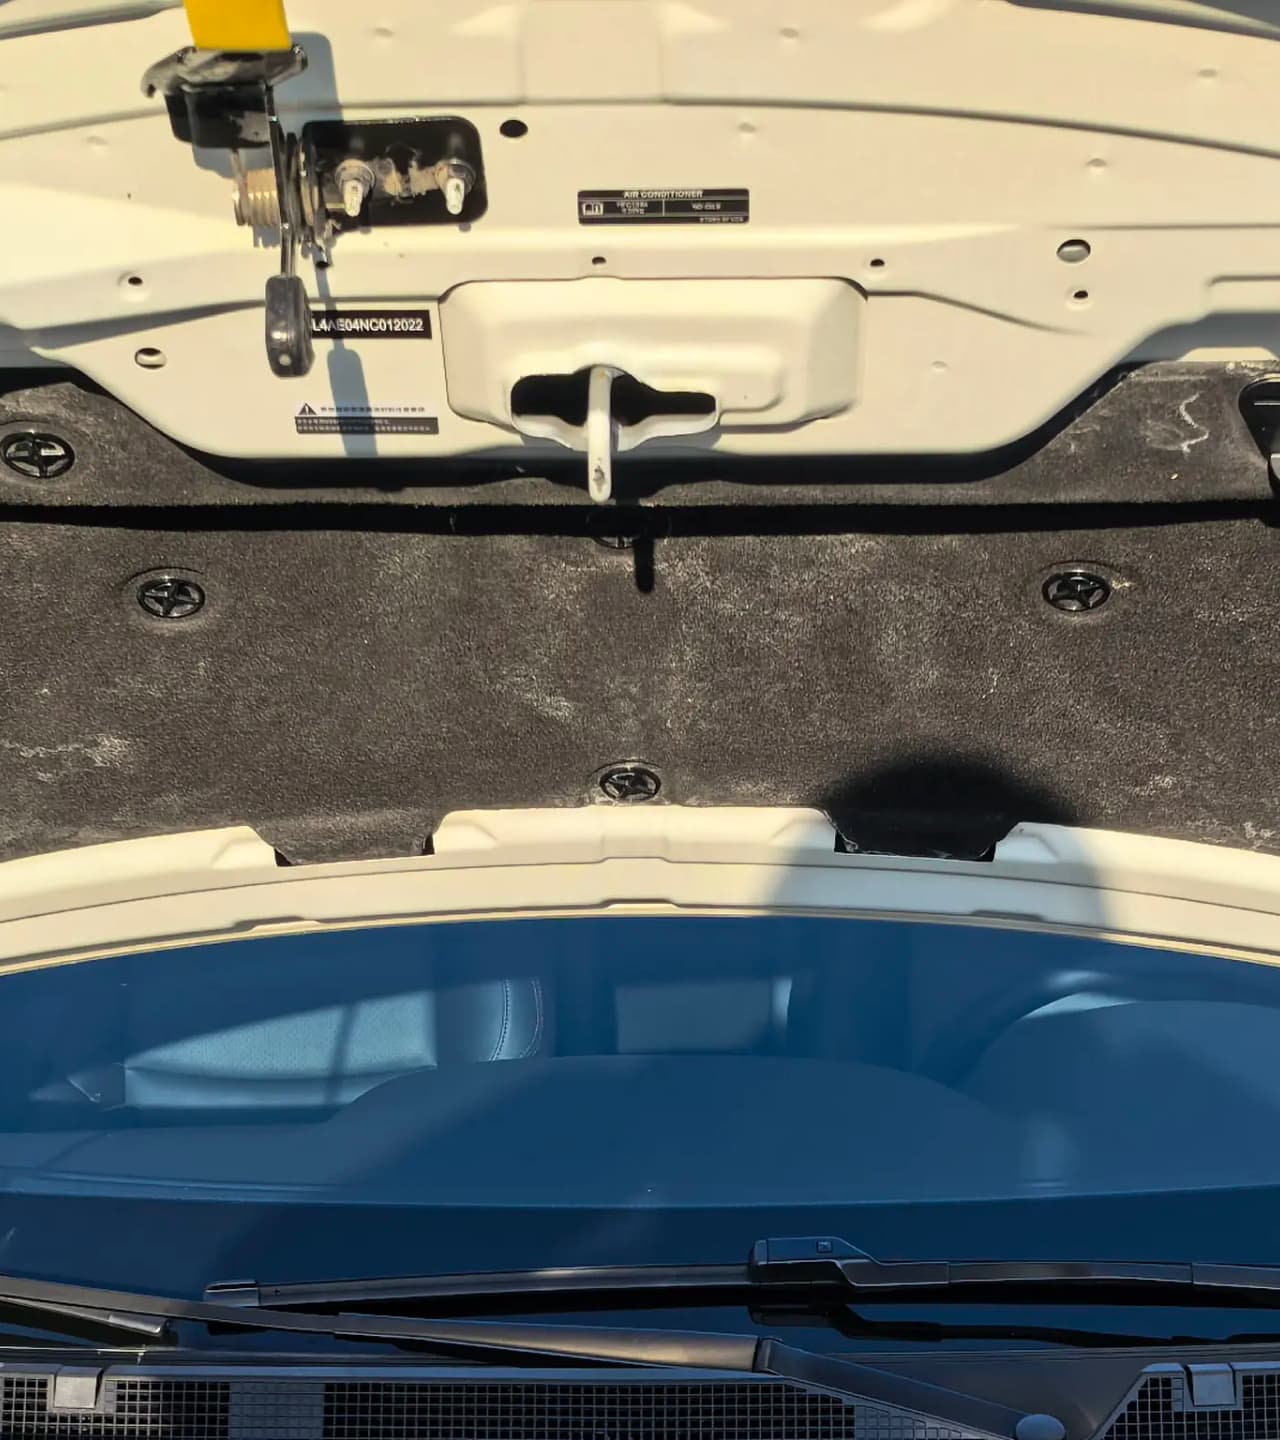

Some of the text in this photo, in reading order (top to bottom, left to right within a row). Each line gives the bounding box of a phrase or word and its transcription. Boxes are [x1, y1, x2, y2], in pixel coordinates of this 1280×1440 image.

[623, 191, 704, 199] AIR CONDITIONER
[311, 318, 425, 332] L4AE04NC012022
